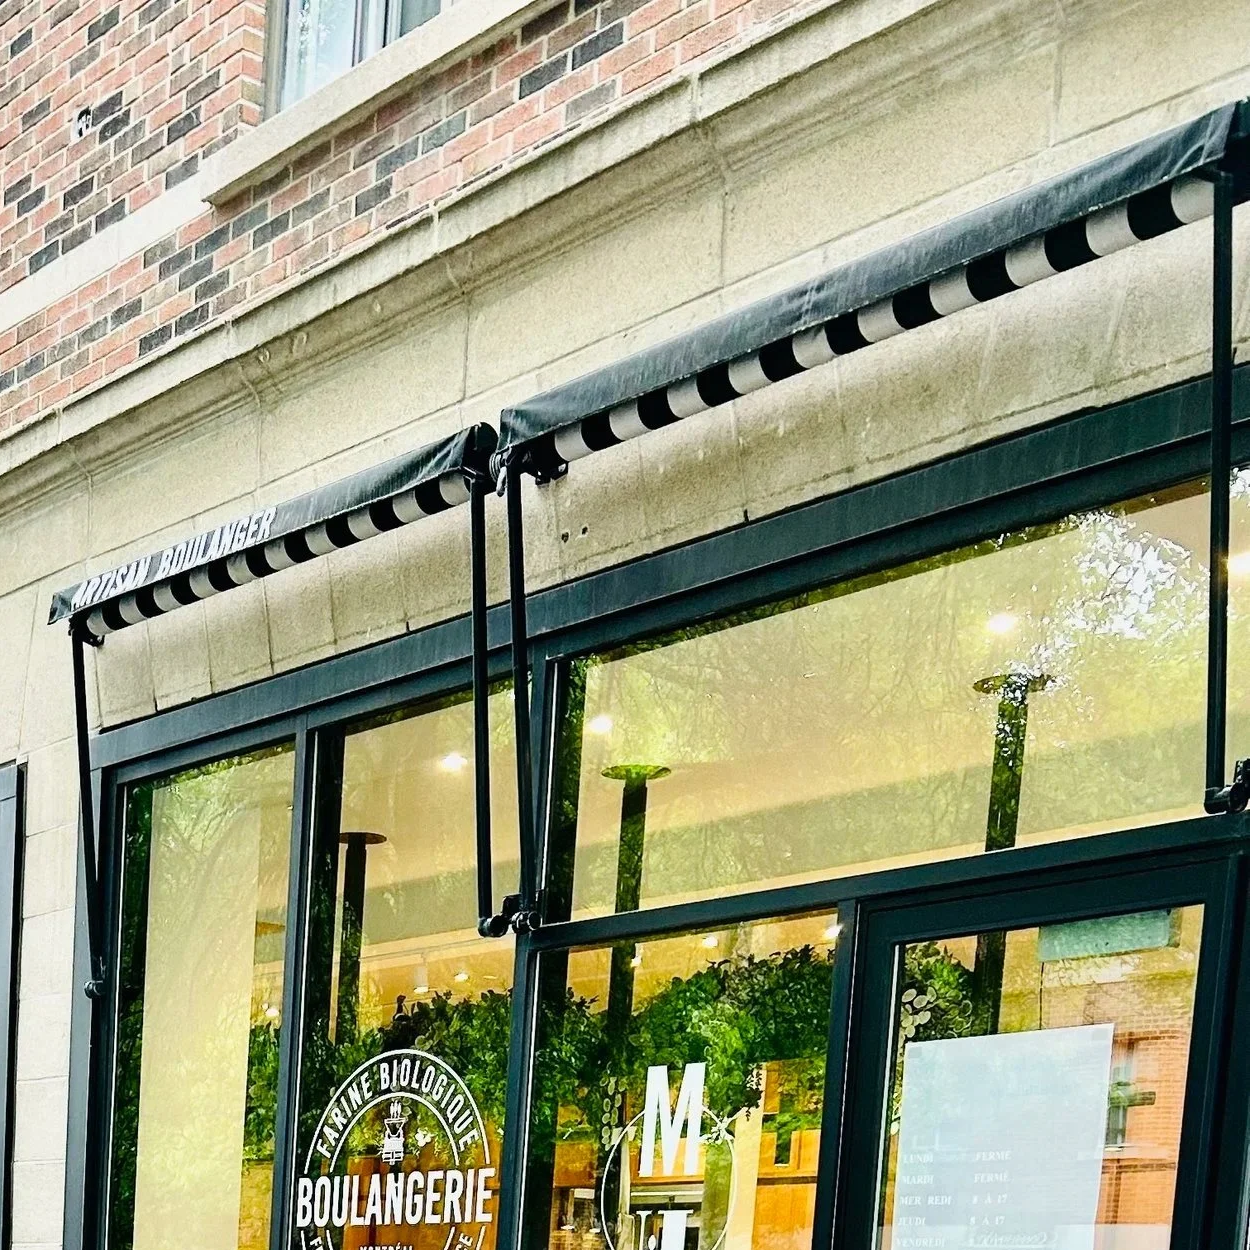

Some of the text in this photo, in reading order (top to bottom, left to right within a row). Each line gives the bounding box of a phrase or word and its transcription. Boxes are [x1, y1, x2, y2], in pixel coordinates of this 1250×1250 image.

[71, 507, 277, 611] ARTISAN BOULANGER
[316, 1058, 480, 1159] FARINE BIOLOGIQUE
[901, 1174, 934, 1185] MARDI
[903, 1153, 934, 1164] LUNDI
[296, 1167, 496, 1228] BOULANGERIE
